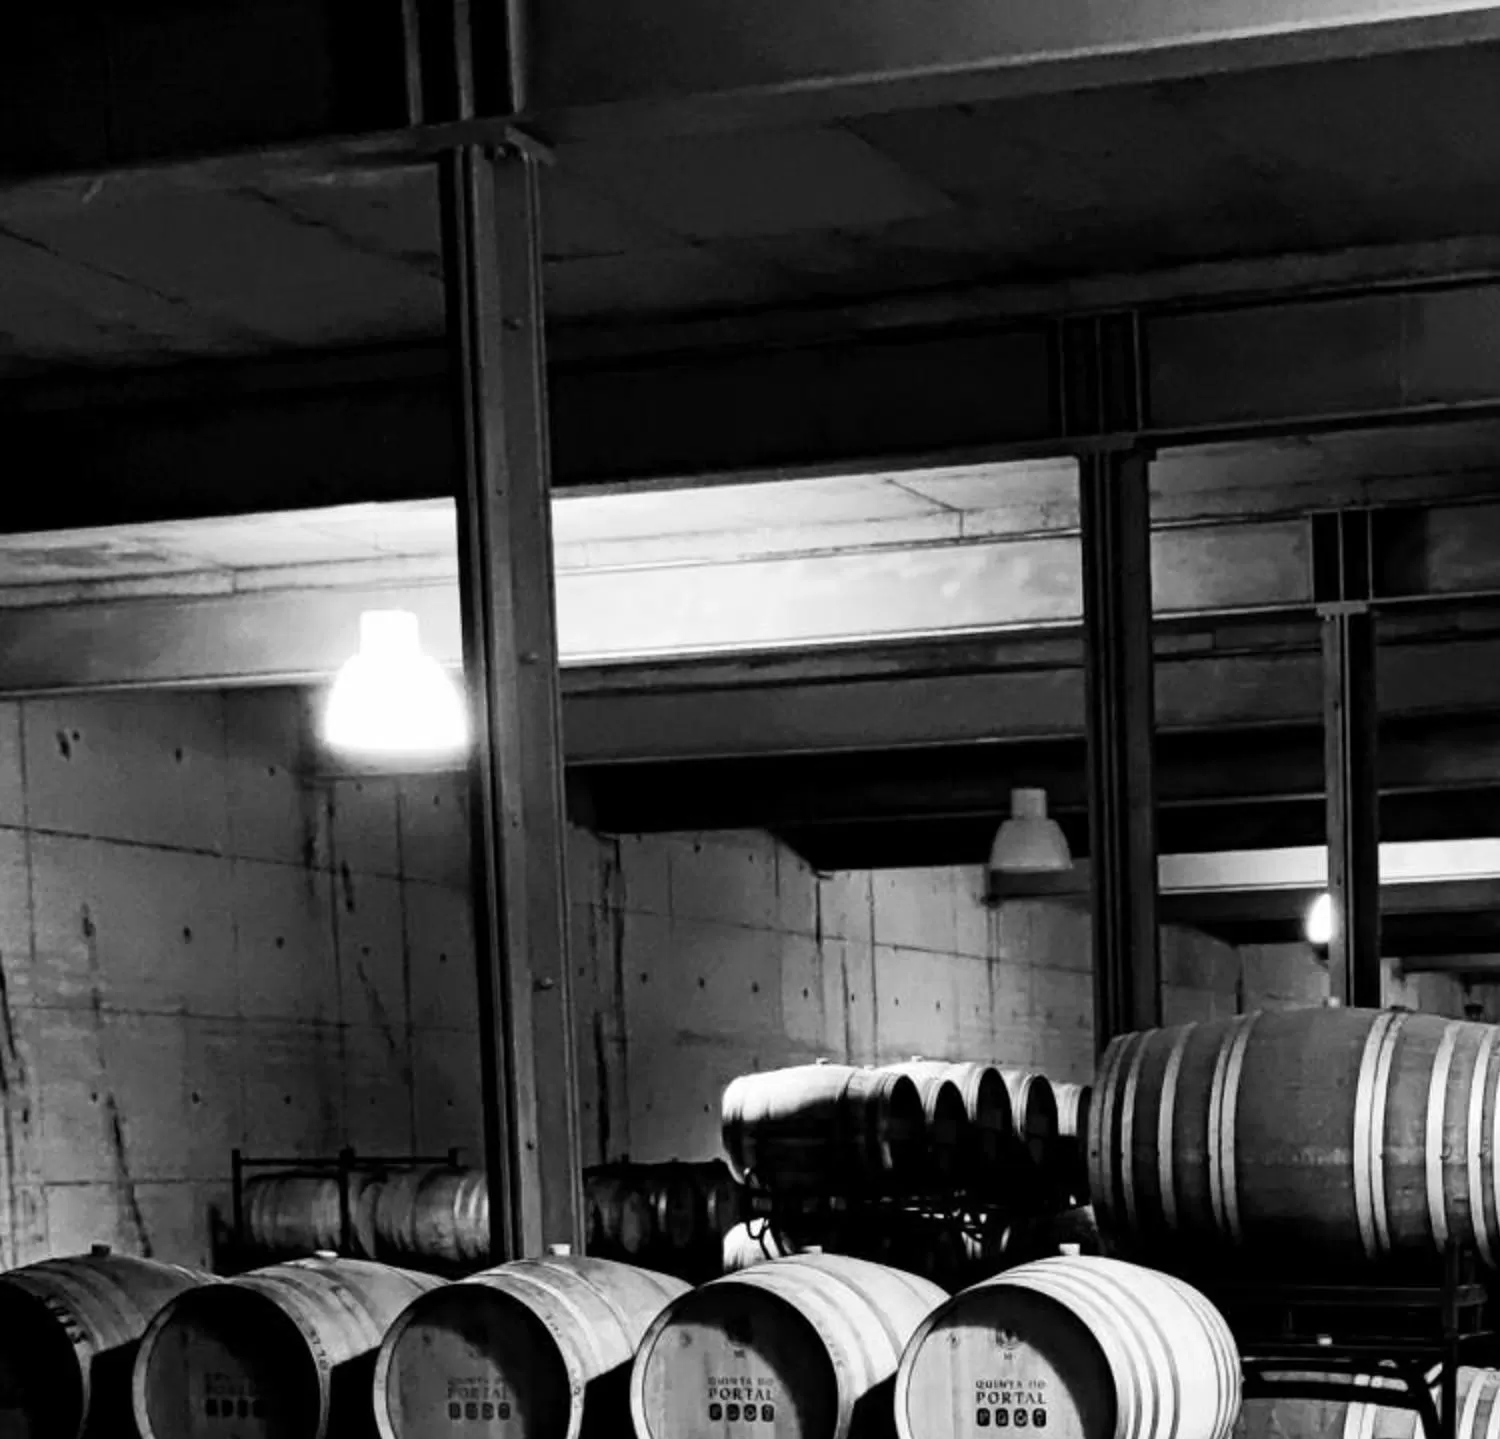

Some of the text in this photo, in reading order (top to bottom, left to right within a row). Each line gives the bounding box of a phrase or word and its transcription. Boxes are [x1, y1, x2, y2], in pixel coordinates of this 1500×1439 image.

[975, 1379, 1023, 1390] QUINTA
[708, 1387, 773, 1401] PORTAL
[975, 1391, 1048, 1405] PORTAL
